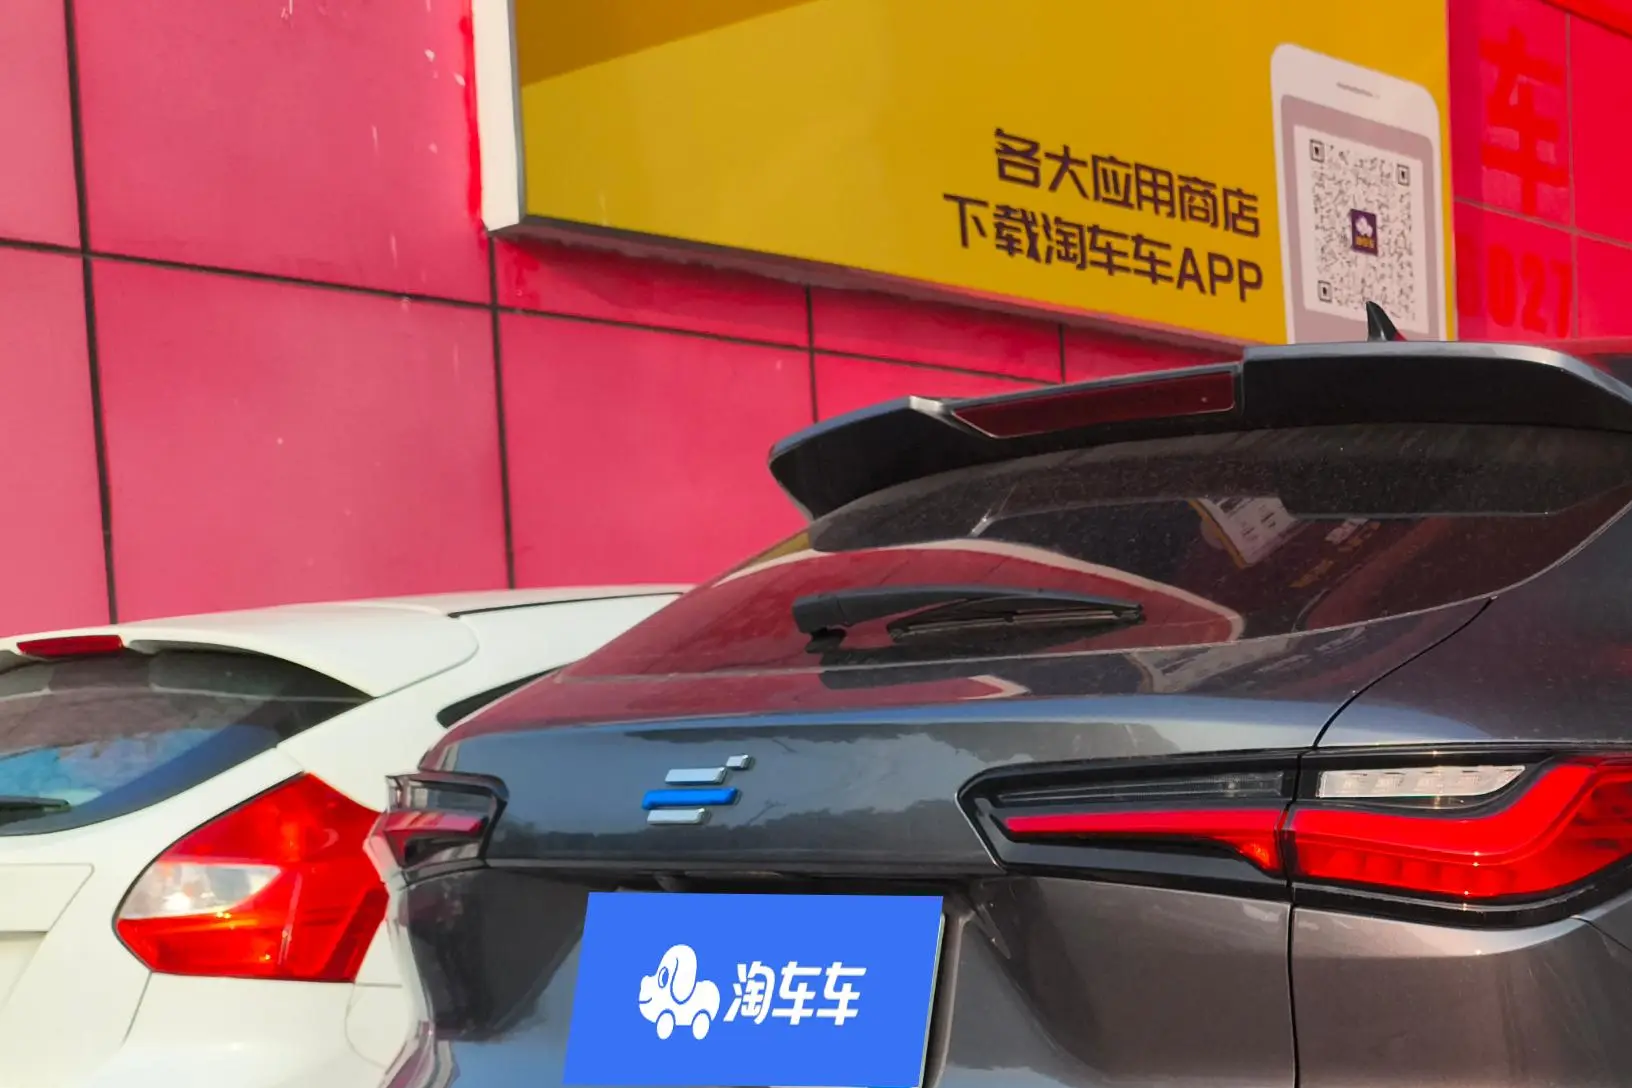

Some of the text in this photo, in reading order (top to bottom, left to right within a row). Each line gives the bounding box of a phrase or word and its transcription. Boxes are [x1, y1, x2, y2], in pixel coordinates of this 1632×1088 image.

[994, 127, 1260, 238] 各大应用商店
[942, 192, 1264, 303] 下载淘车车APP
